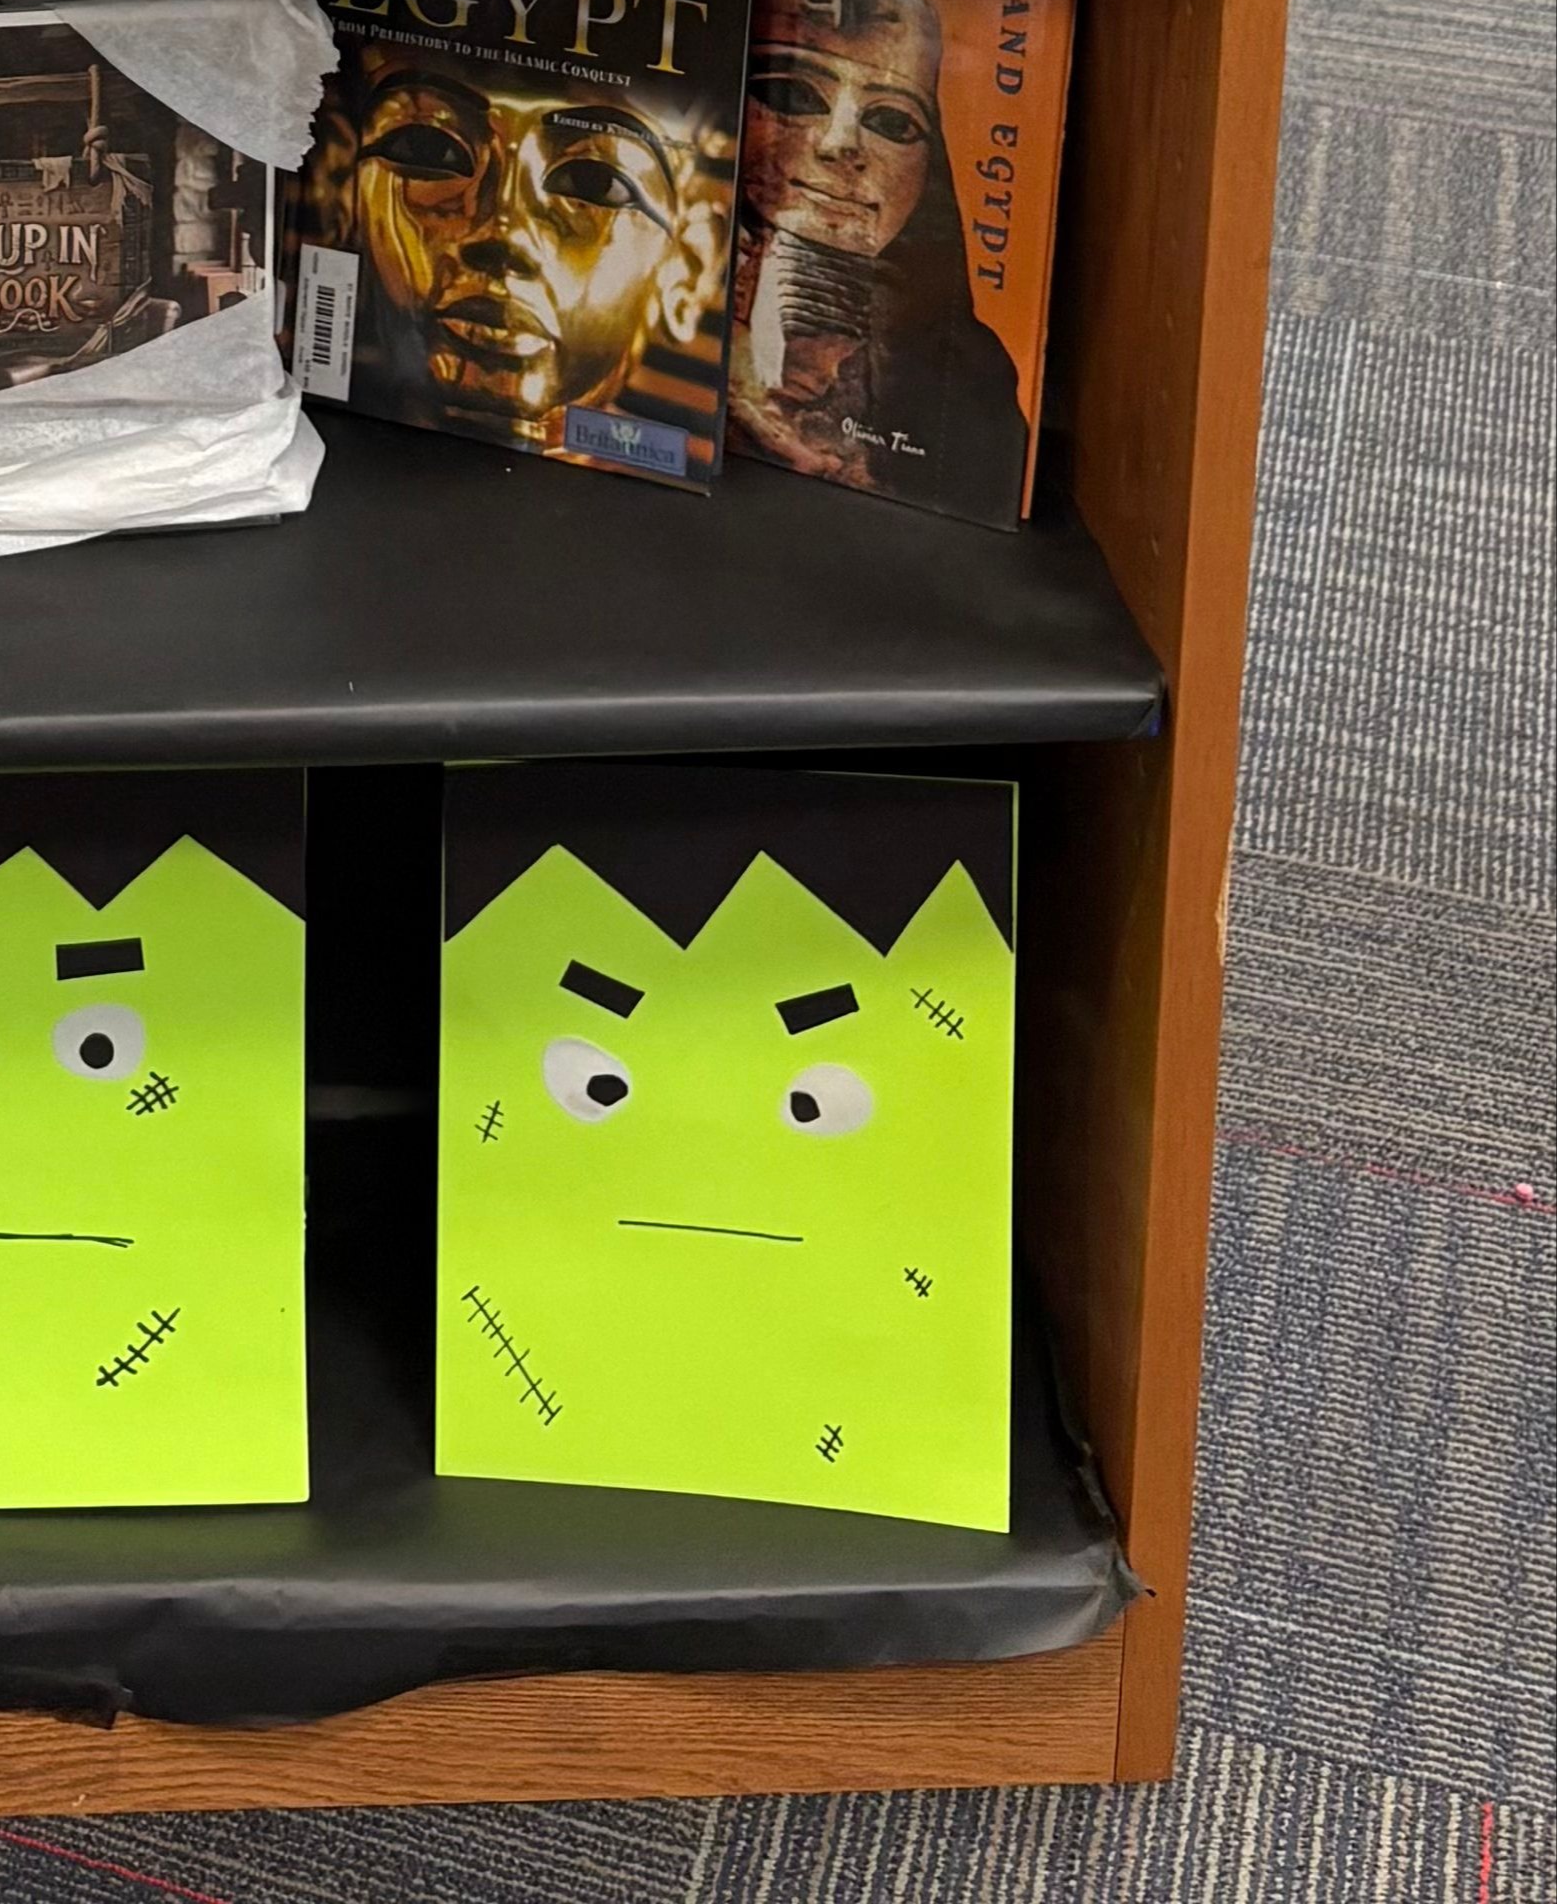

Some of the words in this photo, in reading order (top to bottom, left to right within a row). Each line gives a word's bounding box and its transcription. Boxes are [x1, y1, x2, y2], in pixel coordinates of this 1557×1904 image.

[369, 22, 452, 53] PREHISTORY
[454, 40, 472, 56] TO
[475, 45, 500, 62] THE
[503, 48, 560, 74] ISLAMIC
[561, 60, 633, 88] CONQUEST
[972, 121, 1020, 292] EGYPT
[58, 222, 103, 274] IN
[574, 422, 677, 467] Britannica
